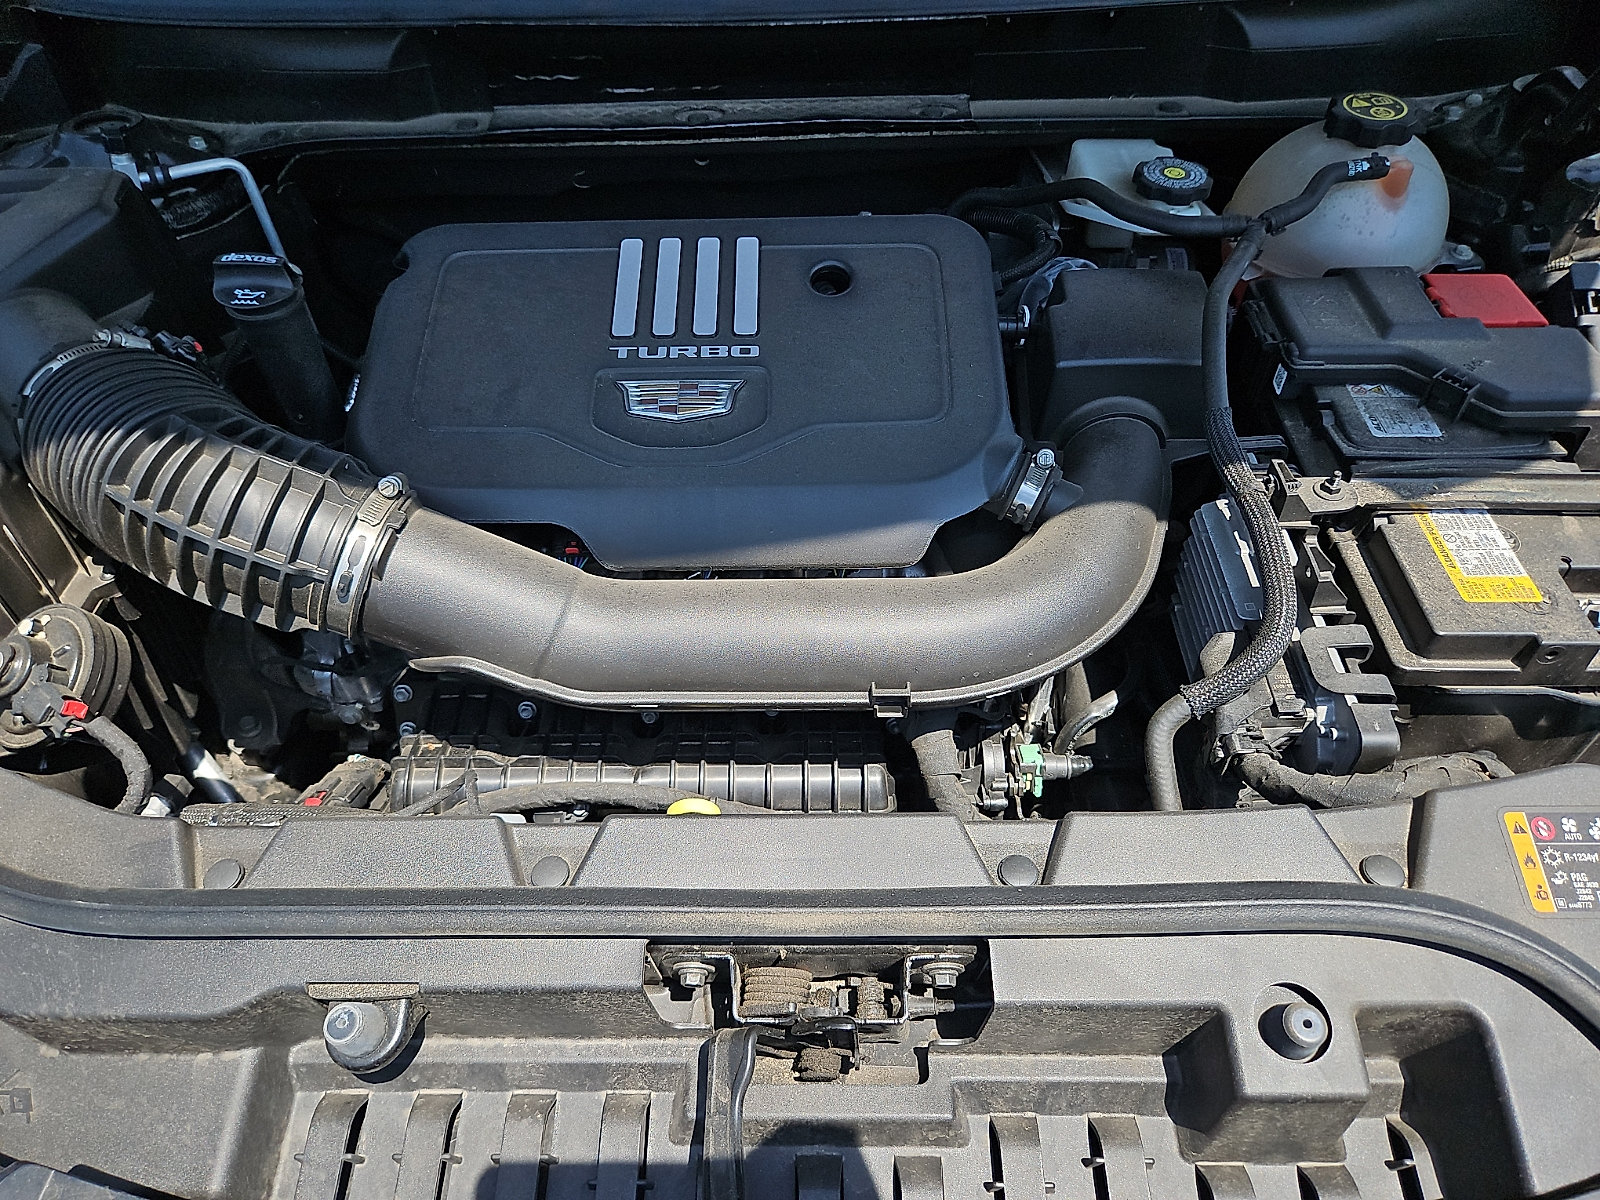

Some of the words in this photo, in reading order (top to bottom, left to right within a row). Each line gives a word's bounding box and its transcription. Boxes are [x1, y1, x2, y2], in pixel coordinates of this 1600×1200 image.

[220, 253, 280, 264] dexos
[608, 345, 760, 359] TURBO
[1431, 535, 1453, 563] DANGER
[1564, 832, 1582, 840] AUTO
[1570, 872, 1588, 881] PAG
